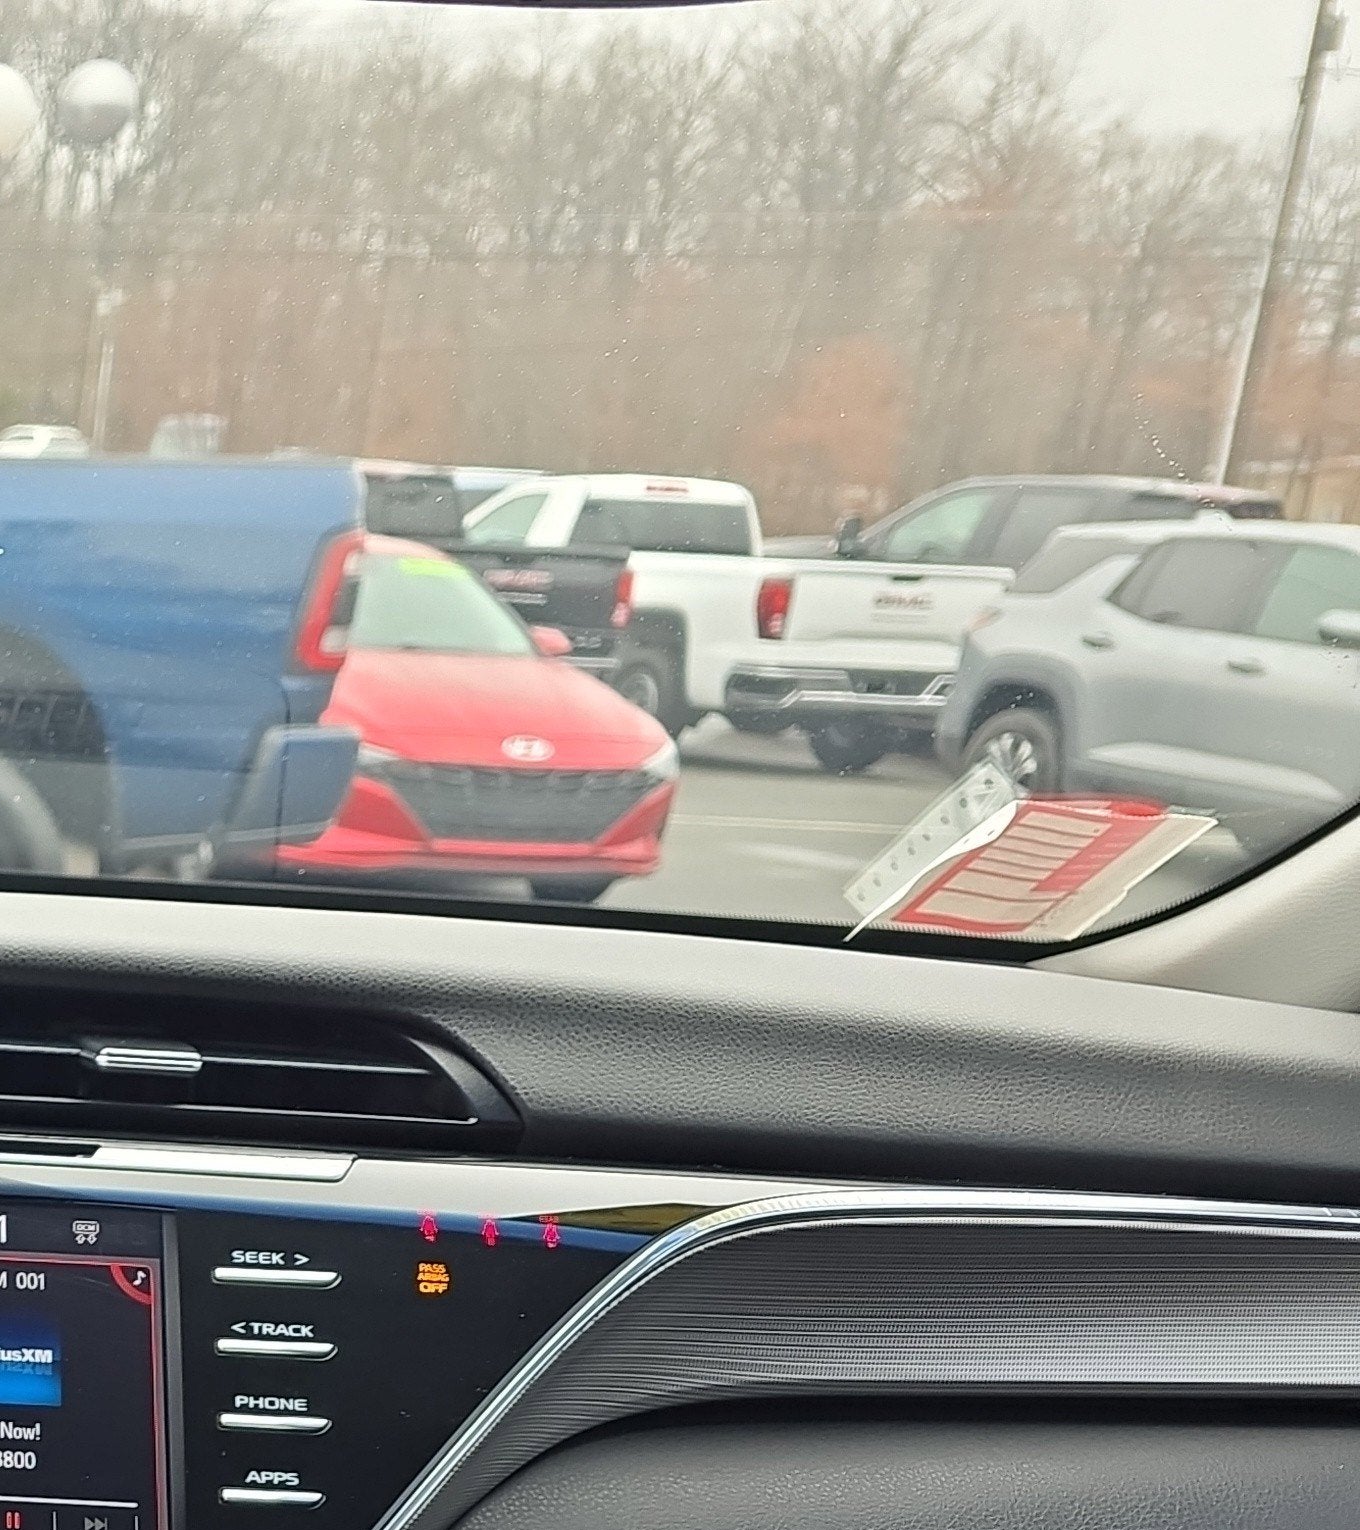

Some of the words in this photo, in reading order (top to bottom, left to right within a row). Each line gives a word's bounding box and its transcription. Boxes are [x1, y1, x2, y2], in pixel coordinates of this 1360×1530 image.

[231, 1250, 285, 1266] SEEK
[418, 1262, 447, 1274] PASS
[15, 1271, 47, 1291] 001
[418, 1282, 448, 1294] OFF
[248, 1322, 315, 1338] TRACK
[233, 1394, 309, 1413] PHONE
[0, 1421, 42, 1442] Now!
[244, 1471, 300, 1487] APPS
